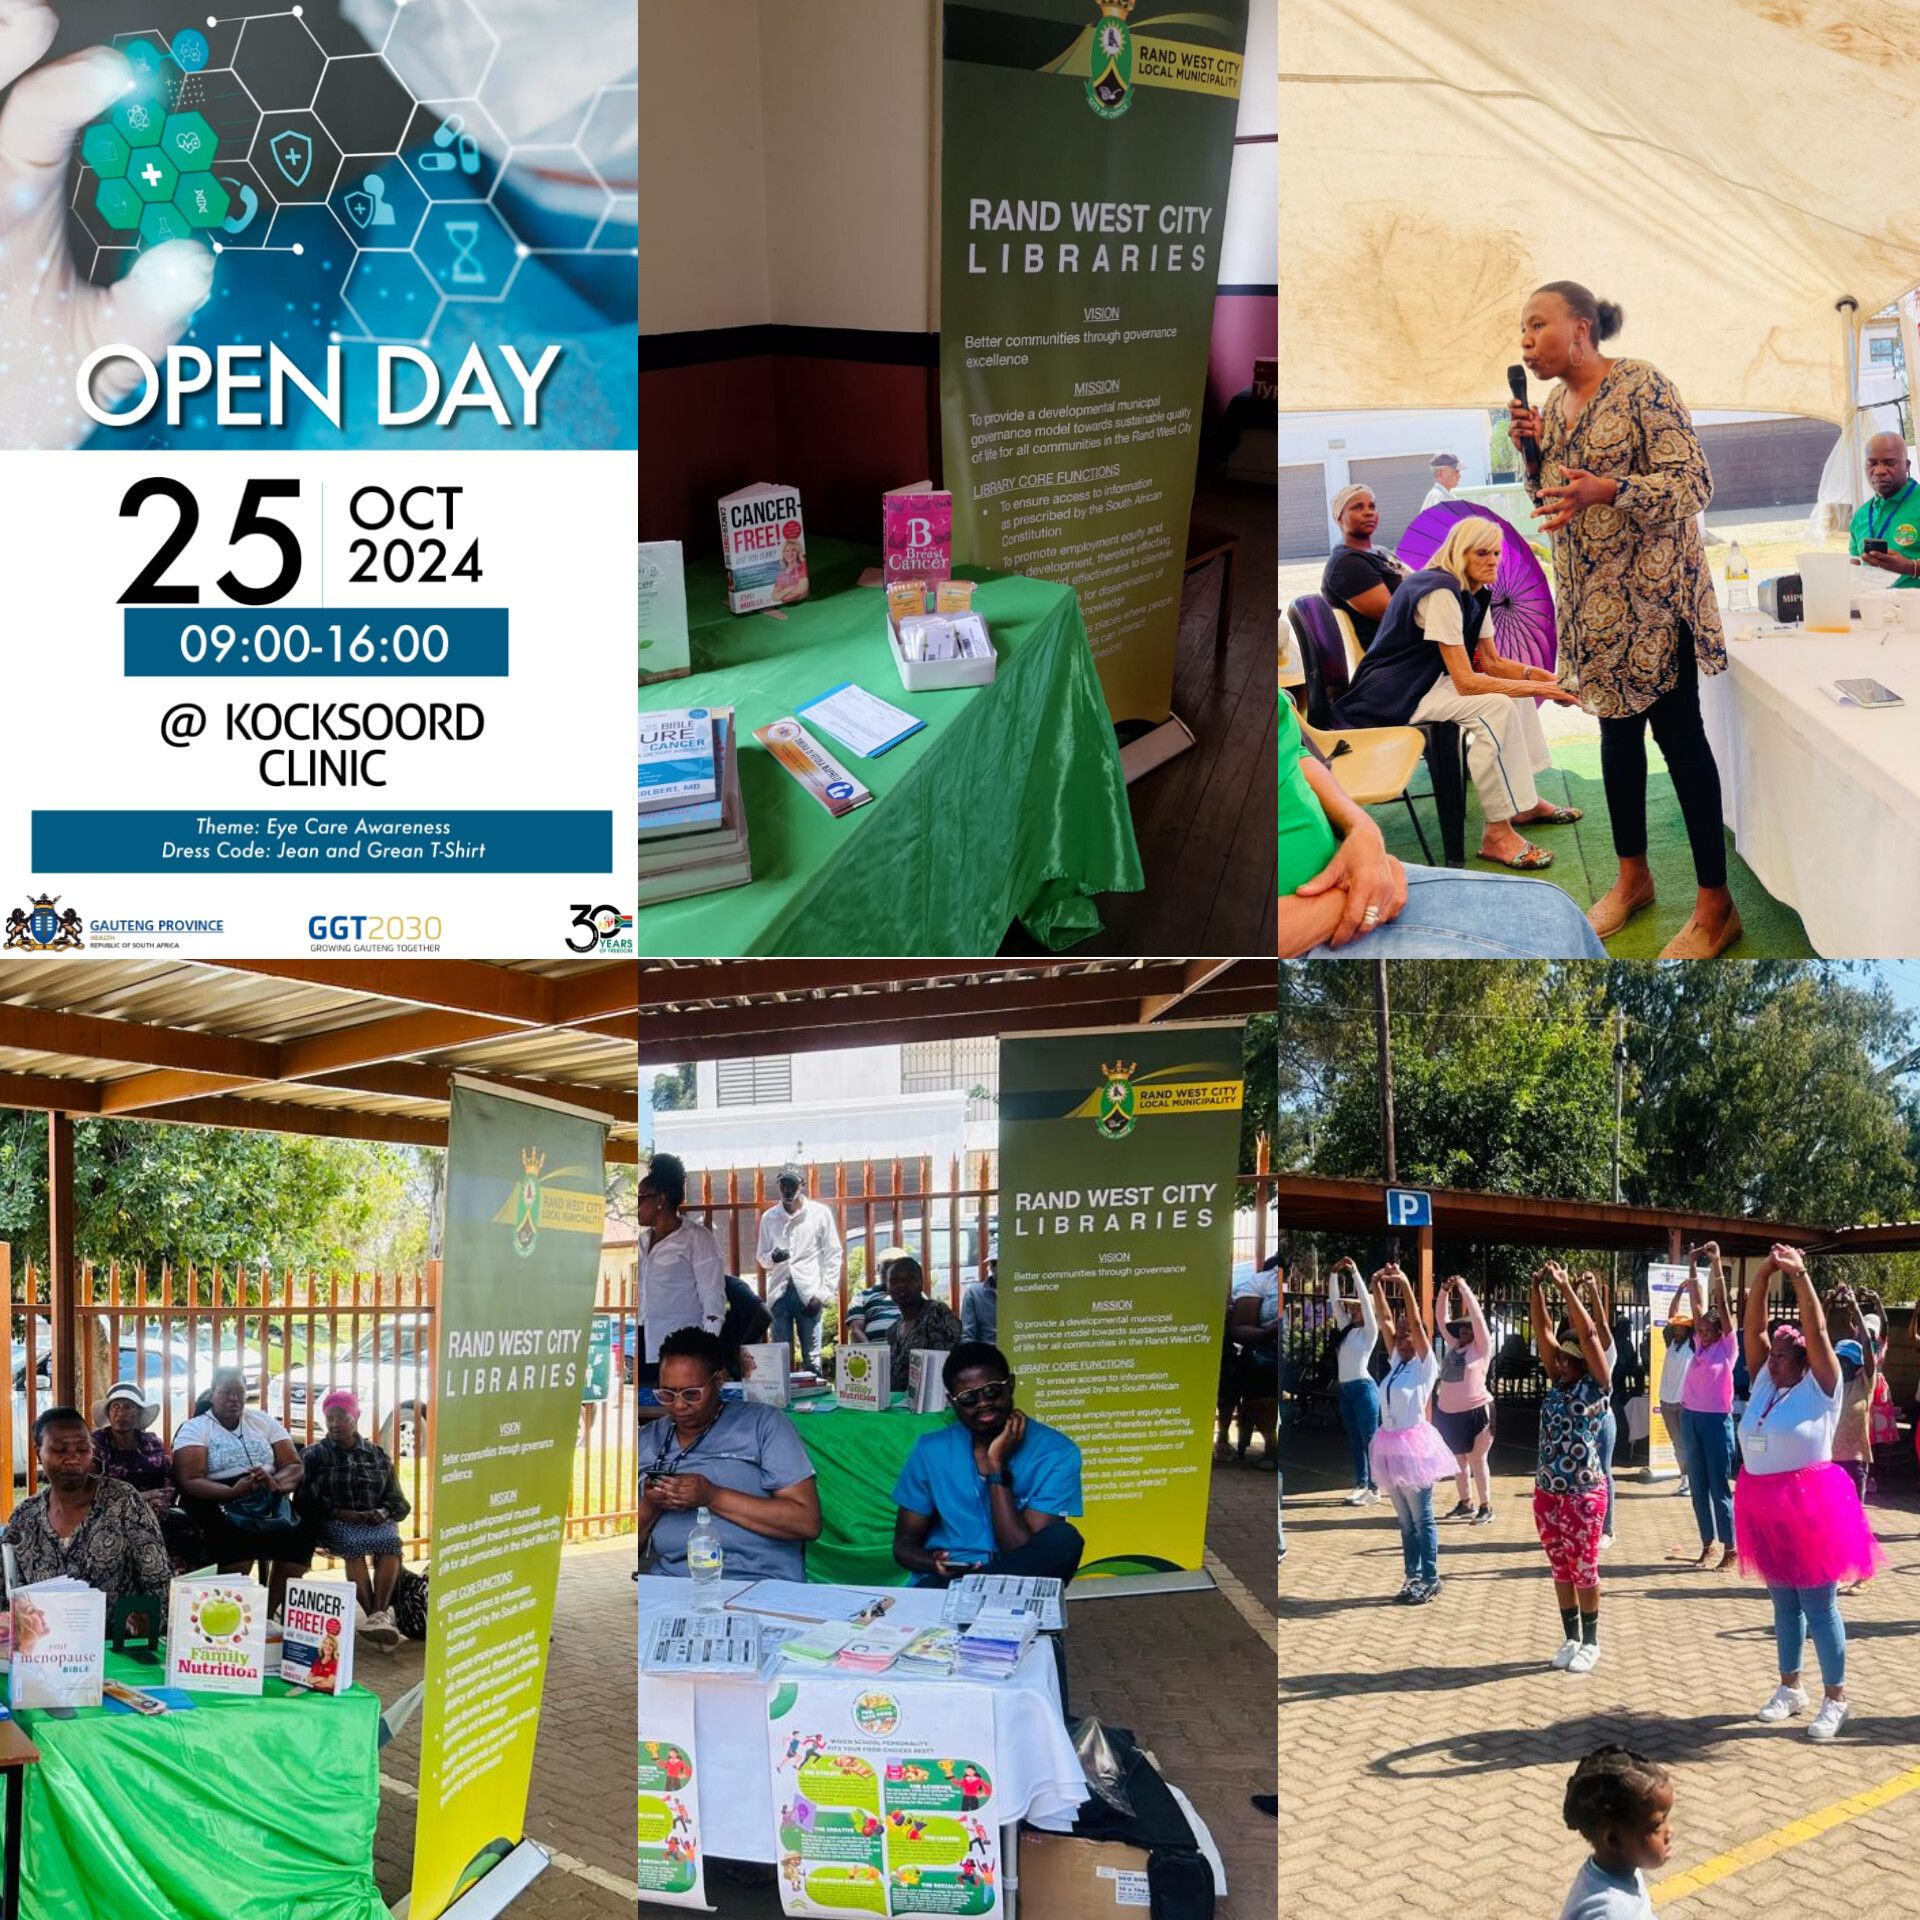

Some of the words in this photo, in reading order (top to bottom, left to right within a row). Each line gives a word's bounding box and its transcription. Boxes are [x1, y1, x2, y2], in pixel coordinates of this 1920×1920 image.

[1140, 46, 1177, 64] RAND
[1182, 52, 1213, 70] WEST
[1217, 59, 1240, 76] CITY
[1139, 62, 1172, 78] LOCAL
[1176, 69, 1238, 88] MUNICIPALITY
[969, 199, 1061, 232] RAND
[1071, 201, 1150, 233] WEST
[1158, 205, 1212, 234] CITY
[968, 244, 1206, 273] LIBRARIES
[1084, 307, 1120, 320] VISION
[964, 336, 1003, 349] Better
[1005, 332, 1080, 346] communities
[1083, 329, 1121, 343] through
[1123, 327, 1177, 341] governance
[966, 353, 1028, 368] excellence
[76, 341, 343, 427] OPEN
[378, 341, 562, 426] DAY
[1074, 380, 1120, 395] MISSION
[969, 413, 982, 427] To
[984, 410, 1024, 425] provide
[1027, 410, 1035, 420] a
[1038, 402, 1115, 419] developmental
[1117, 396, 1161, 409] municipal
[971, 428, 1031, 447] governance
[1035, 424, 1070, 437] model
[1073, 419, 1112, 433] towards
[1115, 411, 1165, 428] sustainable
[1167, 408, 1192, 422] quality
[971, 450, 983, 463] of
[985, 449, 997, 461] life
[999, 446, 1013, 458] for
[1016, 443, 1029, 455] all
[1032, 438, 1101, 454] communities
[1104, 435, 1112, 446] in
[1114, 433, 1129, 444] the
[1132, 429, 1154, 441] Rand
[1157, 426, 1176, 437] West
[1179, 422, 1192, 436] City
[973, 479, 1015, 498] LIBRARY
[1019, 474, 1053, 487] CORE
[1057, 464, 1120, 484] FUNCTIONS
[349, 486, 462, 530] OCT
[1000, 501, 1011, 513] To
[1013, 497, 1050, 510] ensure
[1053, 492, 1090, 504] access
[1093, 489, 1102, 500] to
[1104, 478, 1152, 496] information
[731, 497, 801, 528] CANCER-
[1001, 519, 1011, 530] as
[1014, 508, 1071, 528] prescribed
[1074, 507, 1086, 520] by
[1089, 504, 1103, 514] the
[1106, 498, 1132, 511] South
[1135, 490, 1162, 504] African
[116, 476, 302, 606] 25
[734, 524, 780, 553] FREE!
[907, 518, 932, 547] B
[1002, 526, 1062, 546] Constitution
[1003, 556, 1012, 568] To
[1015, 550, 1056, 565] promote
[1060, 536, 1119, 555] employment
[1121, 530, 1145, 543] equity
[1147, 523, 1163, 534] and
[349, 538, 483, 583] 2024
[889, 555, 949, 571] Cancer
[906, 548, 943, 559] Breast
[1097, 548, 1135, 564] therefore
[1072, 564, 1129, 584] effectiveness
[180, 625, 448, 663] 09:00-16:00
[160, 704, 206, 748] @
[226, 702, 484, 741] KOCKSOORD
[661, 721, 694, 729] BIBLE
[650, 739, 705, 751] CANCER
[259, 749, 387, 787] CLINIC
[196, 818, 260, 835] Theme:
[267, 818, 299, 838] Eye
[305, 818, 348, 835] Care
[355, 818, 450, 835] Awareness
[162, 842, 210, 858] Dress
[216, 842, 270, 858] Code:
[276, 842, 319, 858] Jean
[325, 842, 361, 858] and
[367, 842, 424, 858] Grean
[431, 842, 486, 858] T-Shirt
[90, 920, 154, 931] GAUTENG
[159, 920, 223, 931] PROVINCE
[308, 915, 442, 940] GGT2030
[310, 944, 353, 952] GROWING
[356, 944, 396, 952] GAUTENG
[400, 944, 440, 952] TOGETHER
[600, 940, 632, 948] YEARS
[1140, 1090, 1172, 1099] RAND
[1176, 1088, 1207, 1098] WEST
[1211, 1087, 1236, 1096] CITY
[1140, 1099, 1170, 1108] LOCAL
[1172, 1096, 1236, 1107] MUNICIPALITY
[1016, 1192, 1080, 1211] RAND
[1088, 1187, 1154, 1207] WEST
[1162, 1184, 1217, 1204] CITY
[1399, 1194, 1418, 1225] P
[1016, 1209, 1213, 1236] LIBRARIES
[1099, 1253, 1130, 1262] VISION
[1014, 1272, 1039, 1280] Better
[1042, 1269, 1096, 1279] communities
[1098, 1268, 1132, 1277] through
[1134, 1265, 1186, 1276] governance
[1014, 1283, 1059, 1292] excellence
[1092, 1301, 1132, 1311] MISSION
[448, 1331, 494, 1358] RAND
[499, 1330, 543, 1355] WEST
[548, 1329, 582, 1353] CITY
[446, 1362, 576, 1397] LIBRARIES
[839, 1392, 876, 1402] Nutrition
[289, 1588, 345, 1617] CANCER-
[287, 1609, 324, 1635] FREE!
[21, 1653, 96, 1667] menopause
[178, 1659, 257, 1678] Nutrition
[191, 1647, 249, 1666] Family
